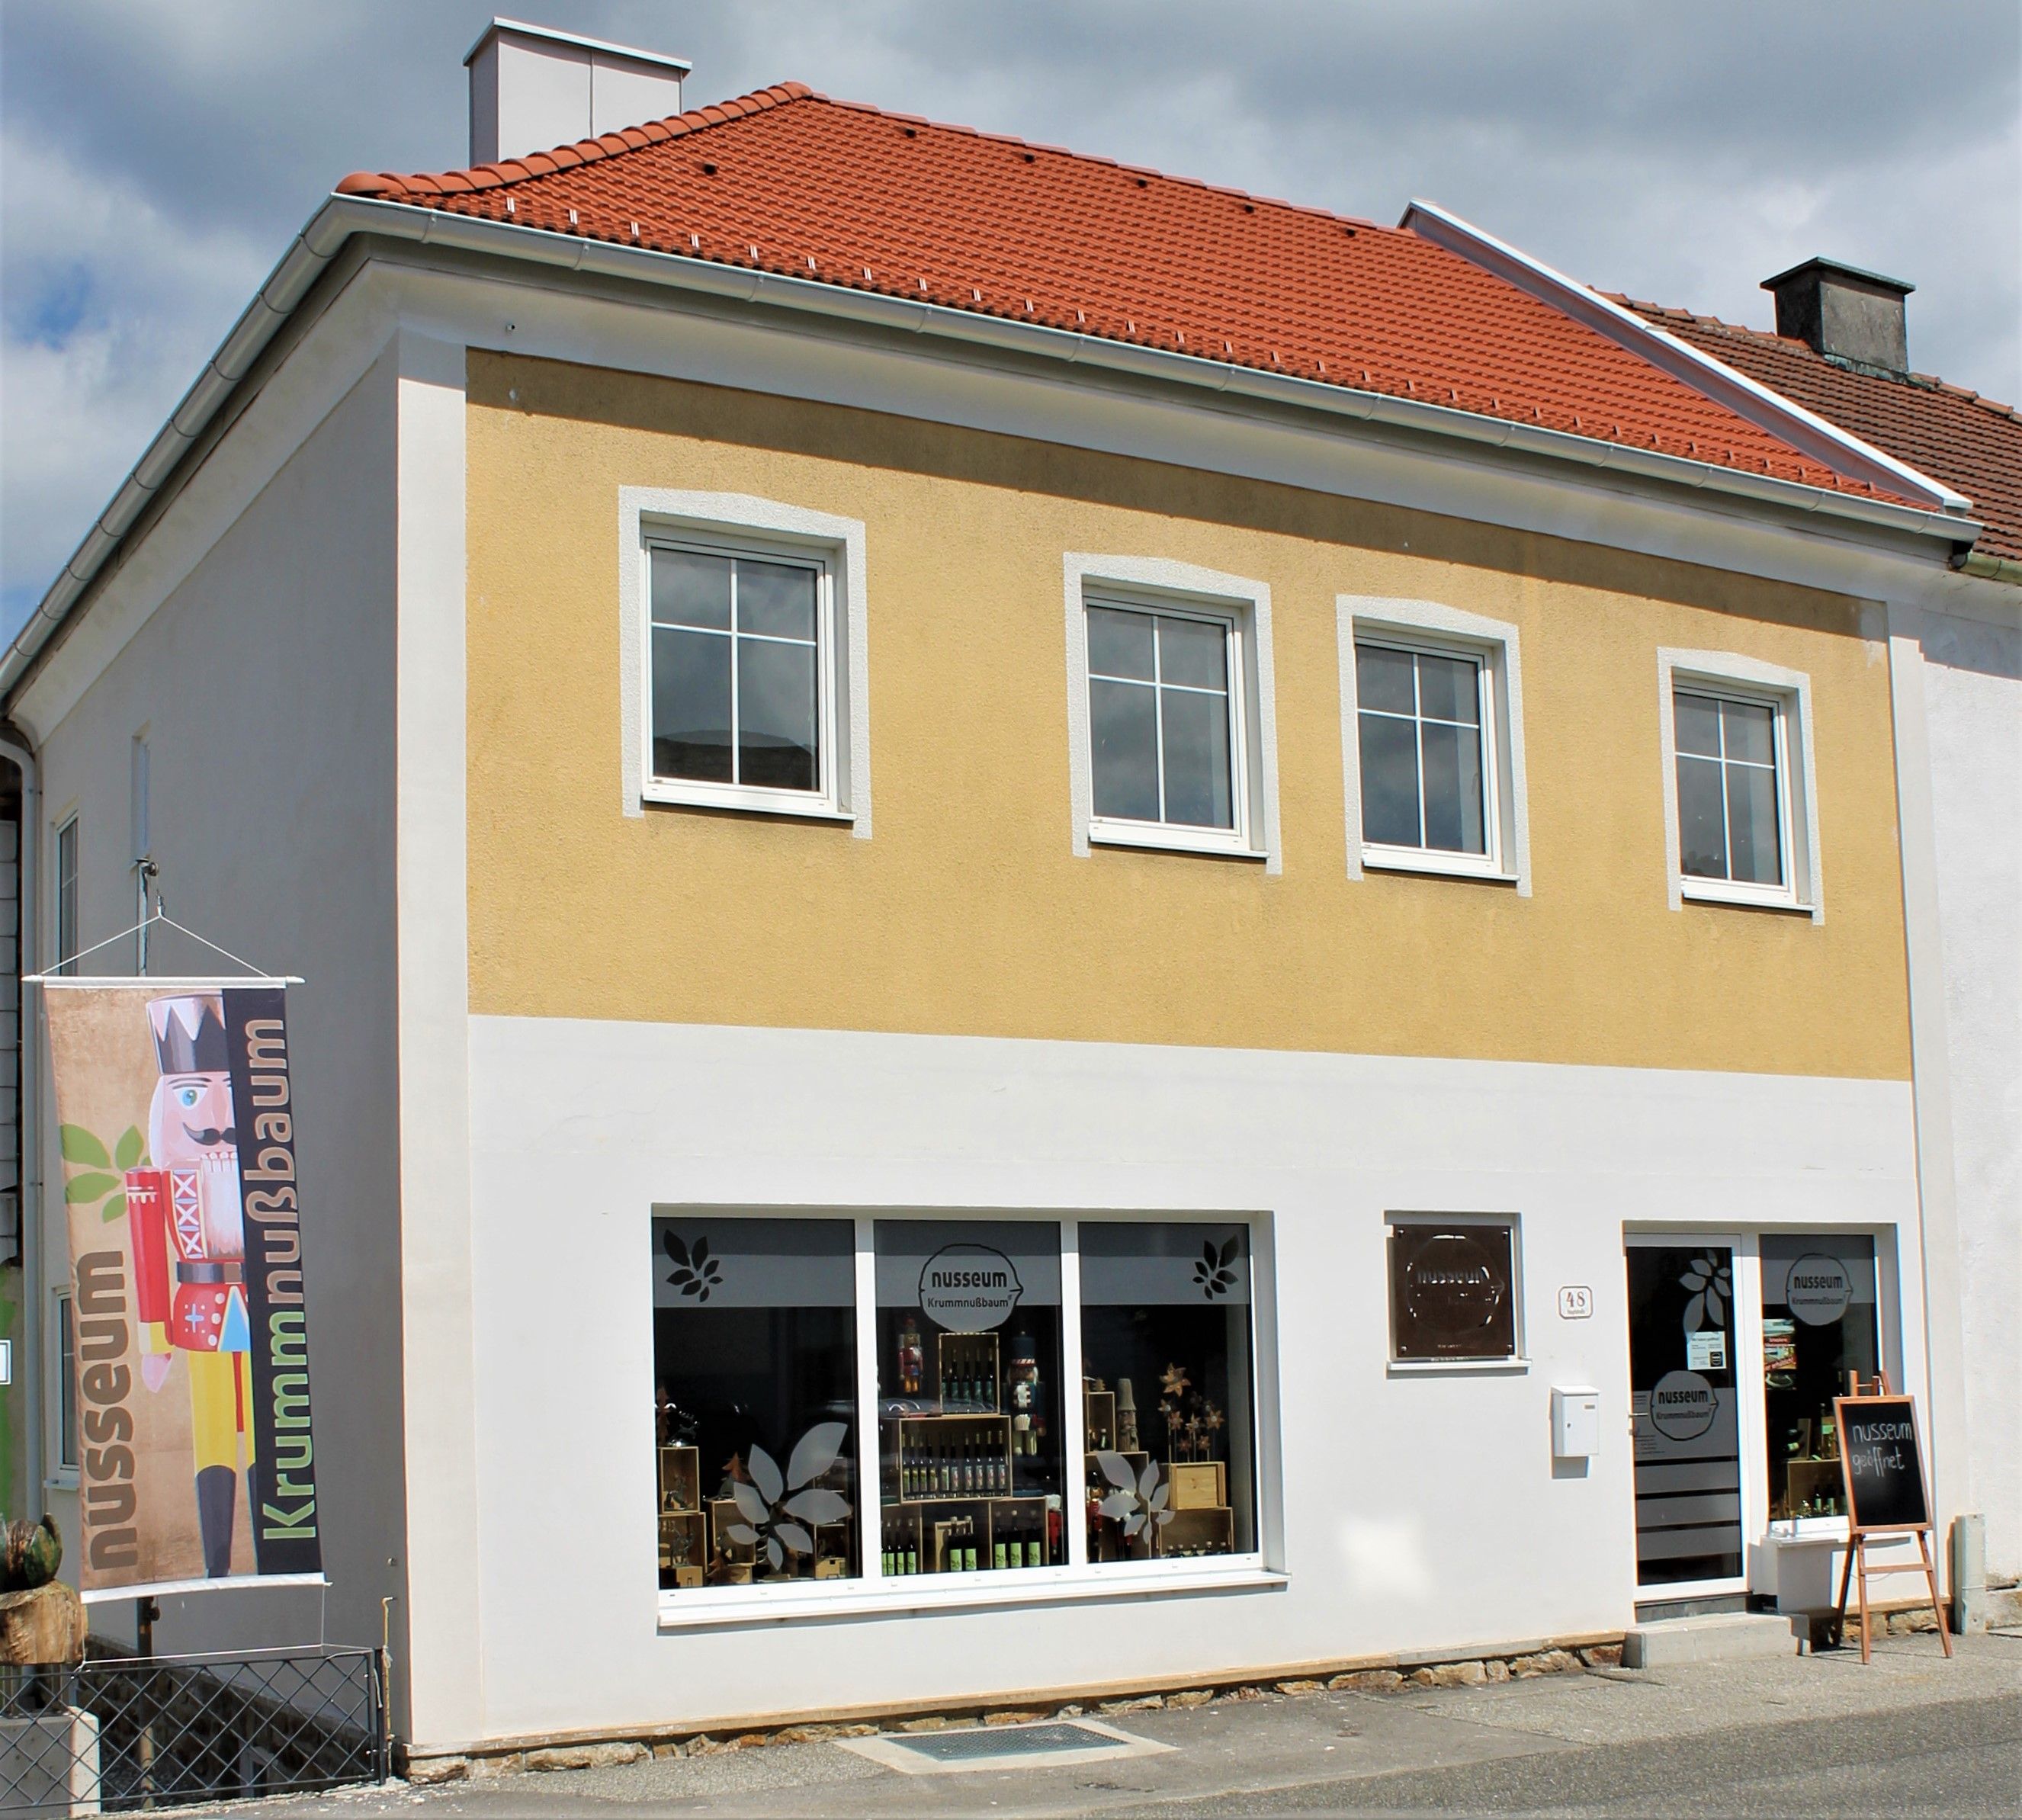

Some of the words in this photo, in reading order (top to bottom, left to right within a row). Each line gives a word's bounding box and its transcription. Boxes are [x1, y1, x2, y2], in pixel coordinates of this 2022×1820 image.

[244, 1019, 316, 1542] Krummnußbaum
[932, 1271, 1007, 1288] nusseum
[1793, 1276, 1843, 1289] nusseum
[928, 1297, 1009, 1308] Krummnußbaum
[1567, 1292, 1585, 1308] 48
[1658, 1390, 1708, 1404] nusseum
[72, 1250, 138, 1571] nusseum
[1852, 1423, 1912, 1443] nusseum
[1852, 1446, 1905, 1477] geöffnet
